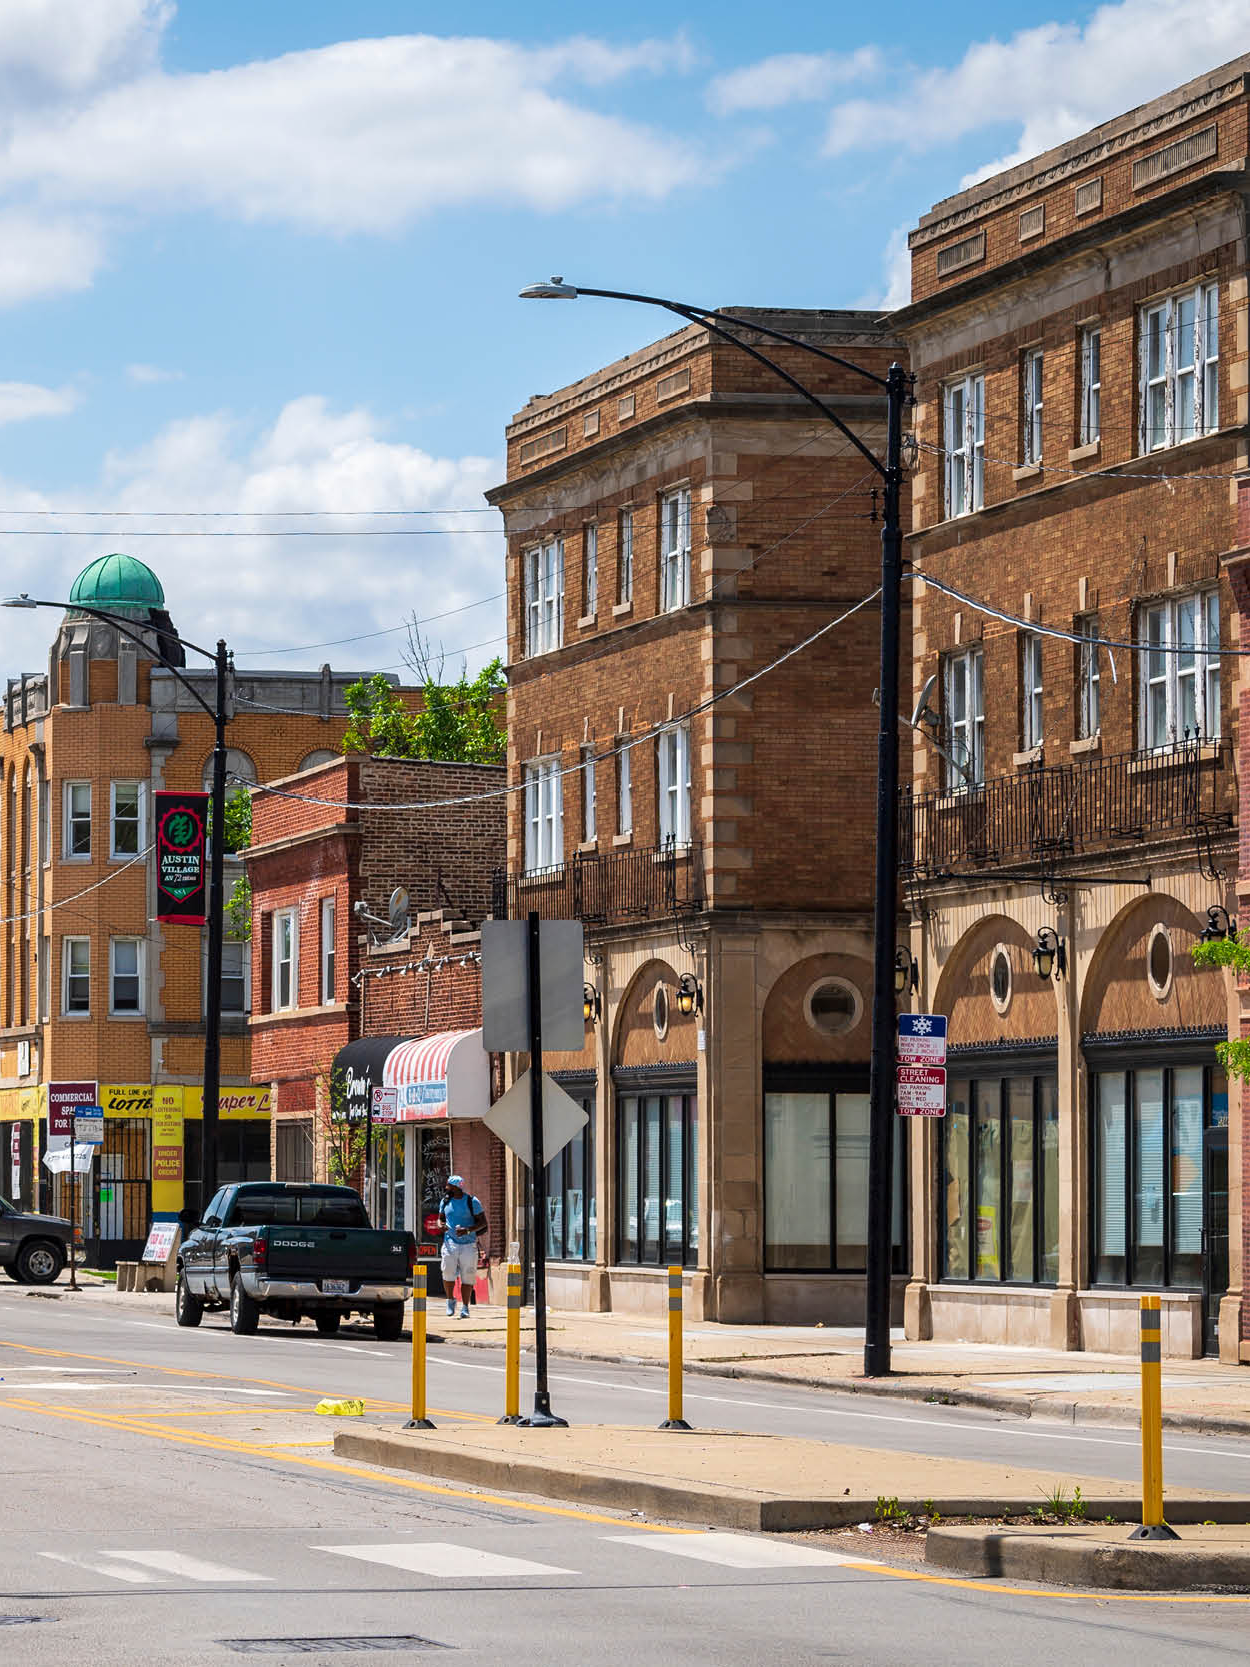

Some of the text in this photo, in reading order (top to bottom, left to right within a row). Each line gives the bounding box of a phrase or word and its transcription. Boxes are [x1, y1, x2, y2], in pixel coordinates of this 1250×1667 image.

[161, 855, 200, 865] AUSTIN
[50, 1093, 94, 1102] COMMERCIAL
[162, 1096, 174, 1105] NO
[55, 1119, 67, 1128] FOR
[273, 1240, 315, 1248] DODGE
[418, 1246, 437, 1255] OPEN
